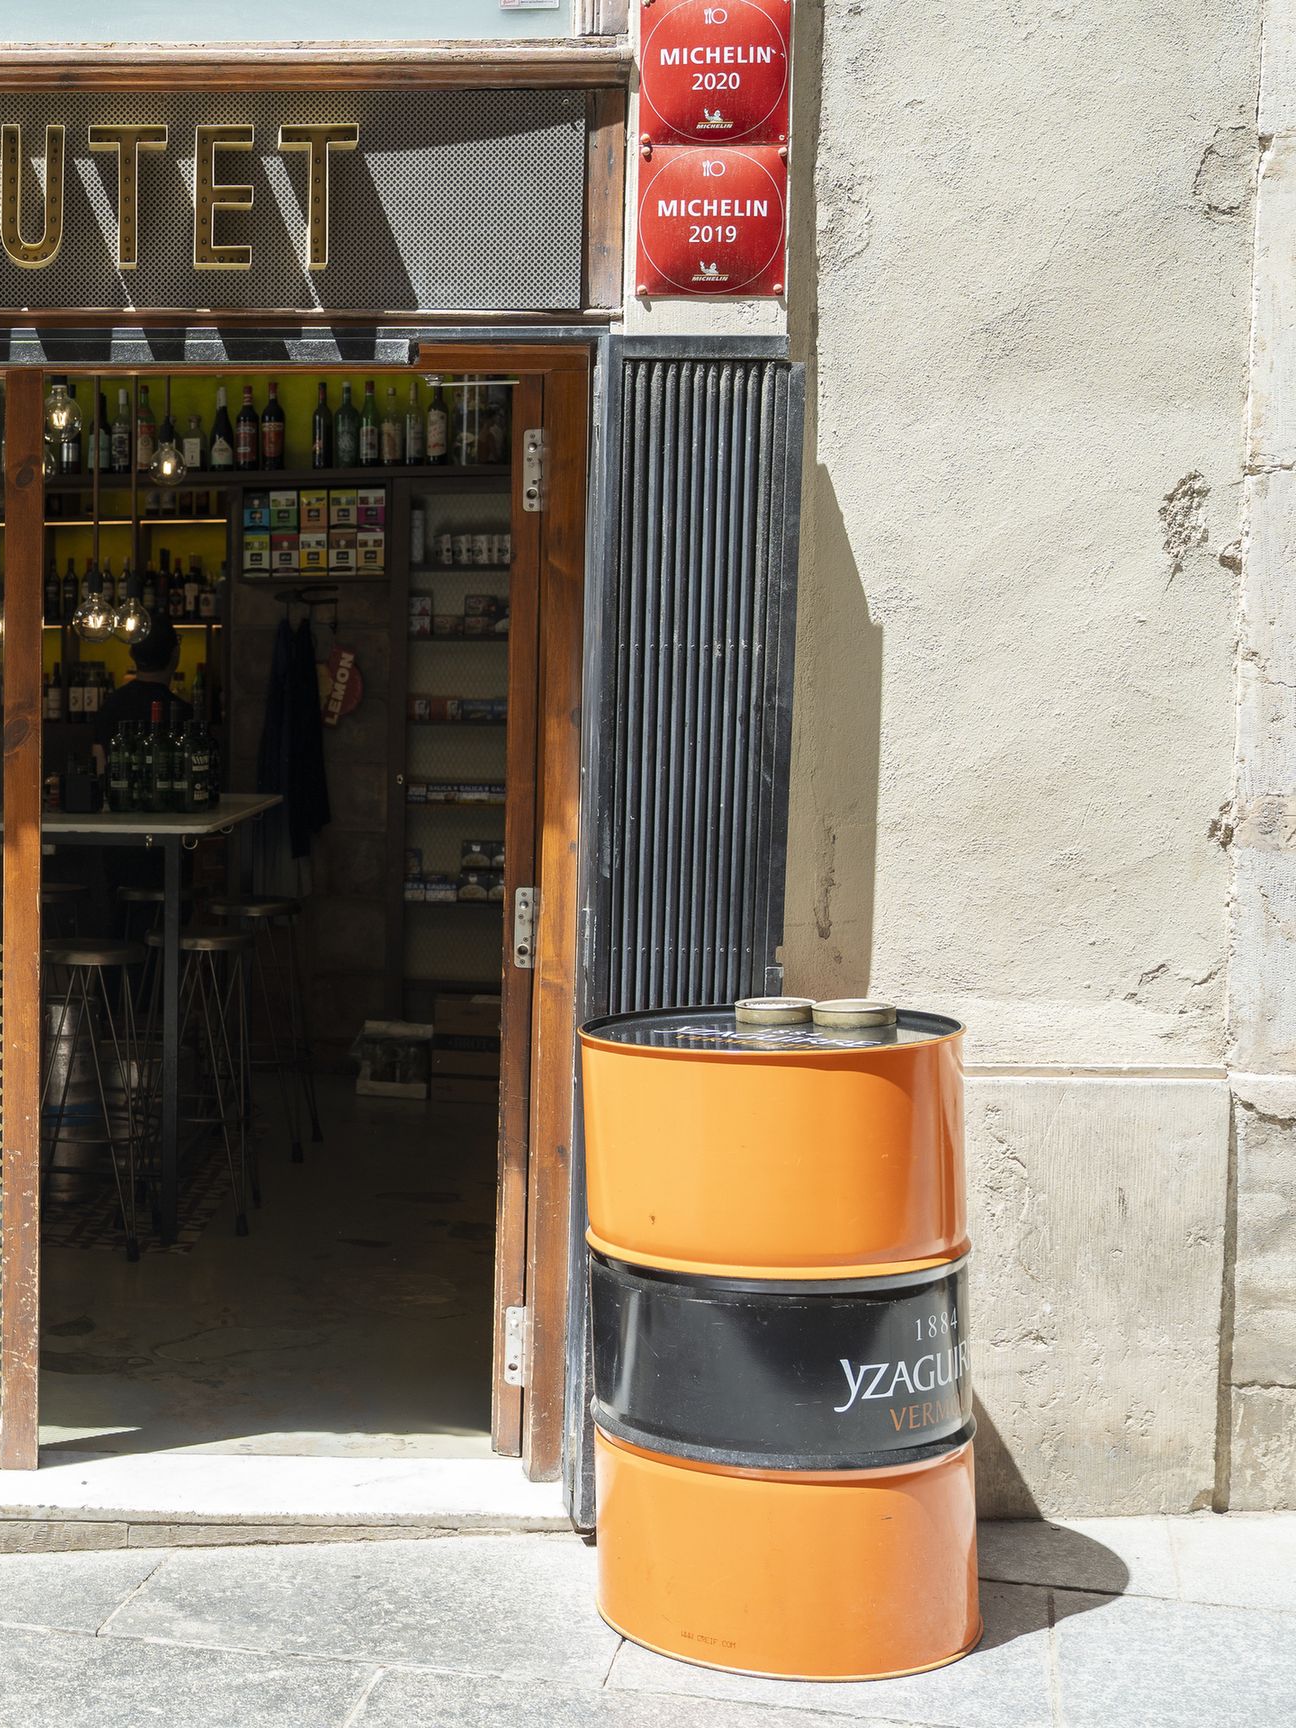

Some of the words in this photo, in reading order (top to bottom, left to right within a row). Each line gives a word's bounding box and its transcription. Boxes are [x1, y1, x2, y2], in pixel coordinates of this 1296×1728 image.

[660, 46, 771, 66] MICHELIN
[692, 72, 741, 91] 2020
[657, 199, 768, 218] MICHELIN
[688, 225, 737, 244] 2019
[324, 651, 354, 726] LEMON
[914, 1307, 958, 1342] 1884
